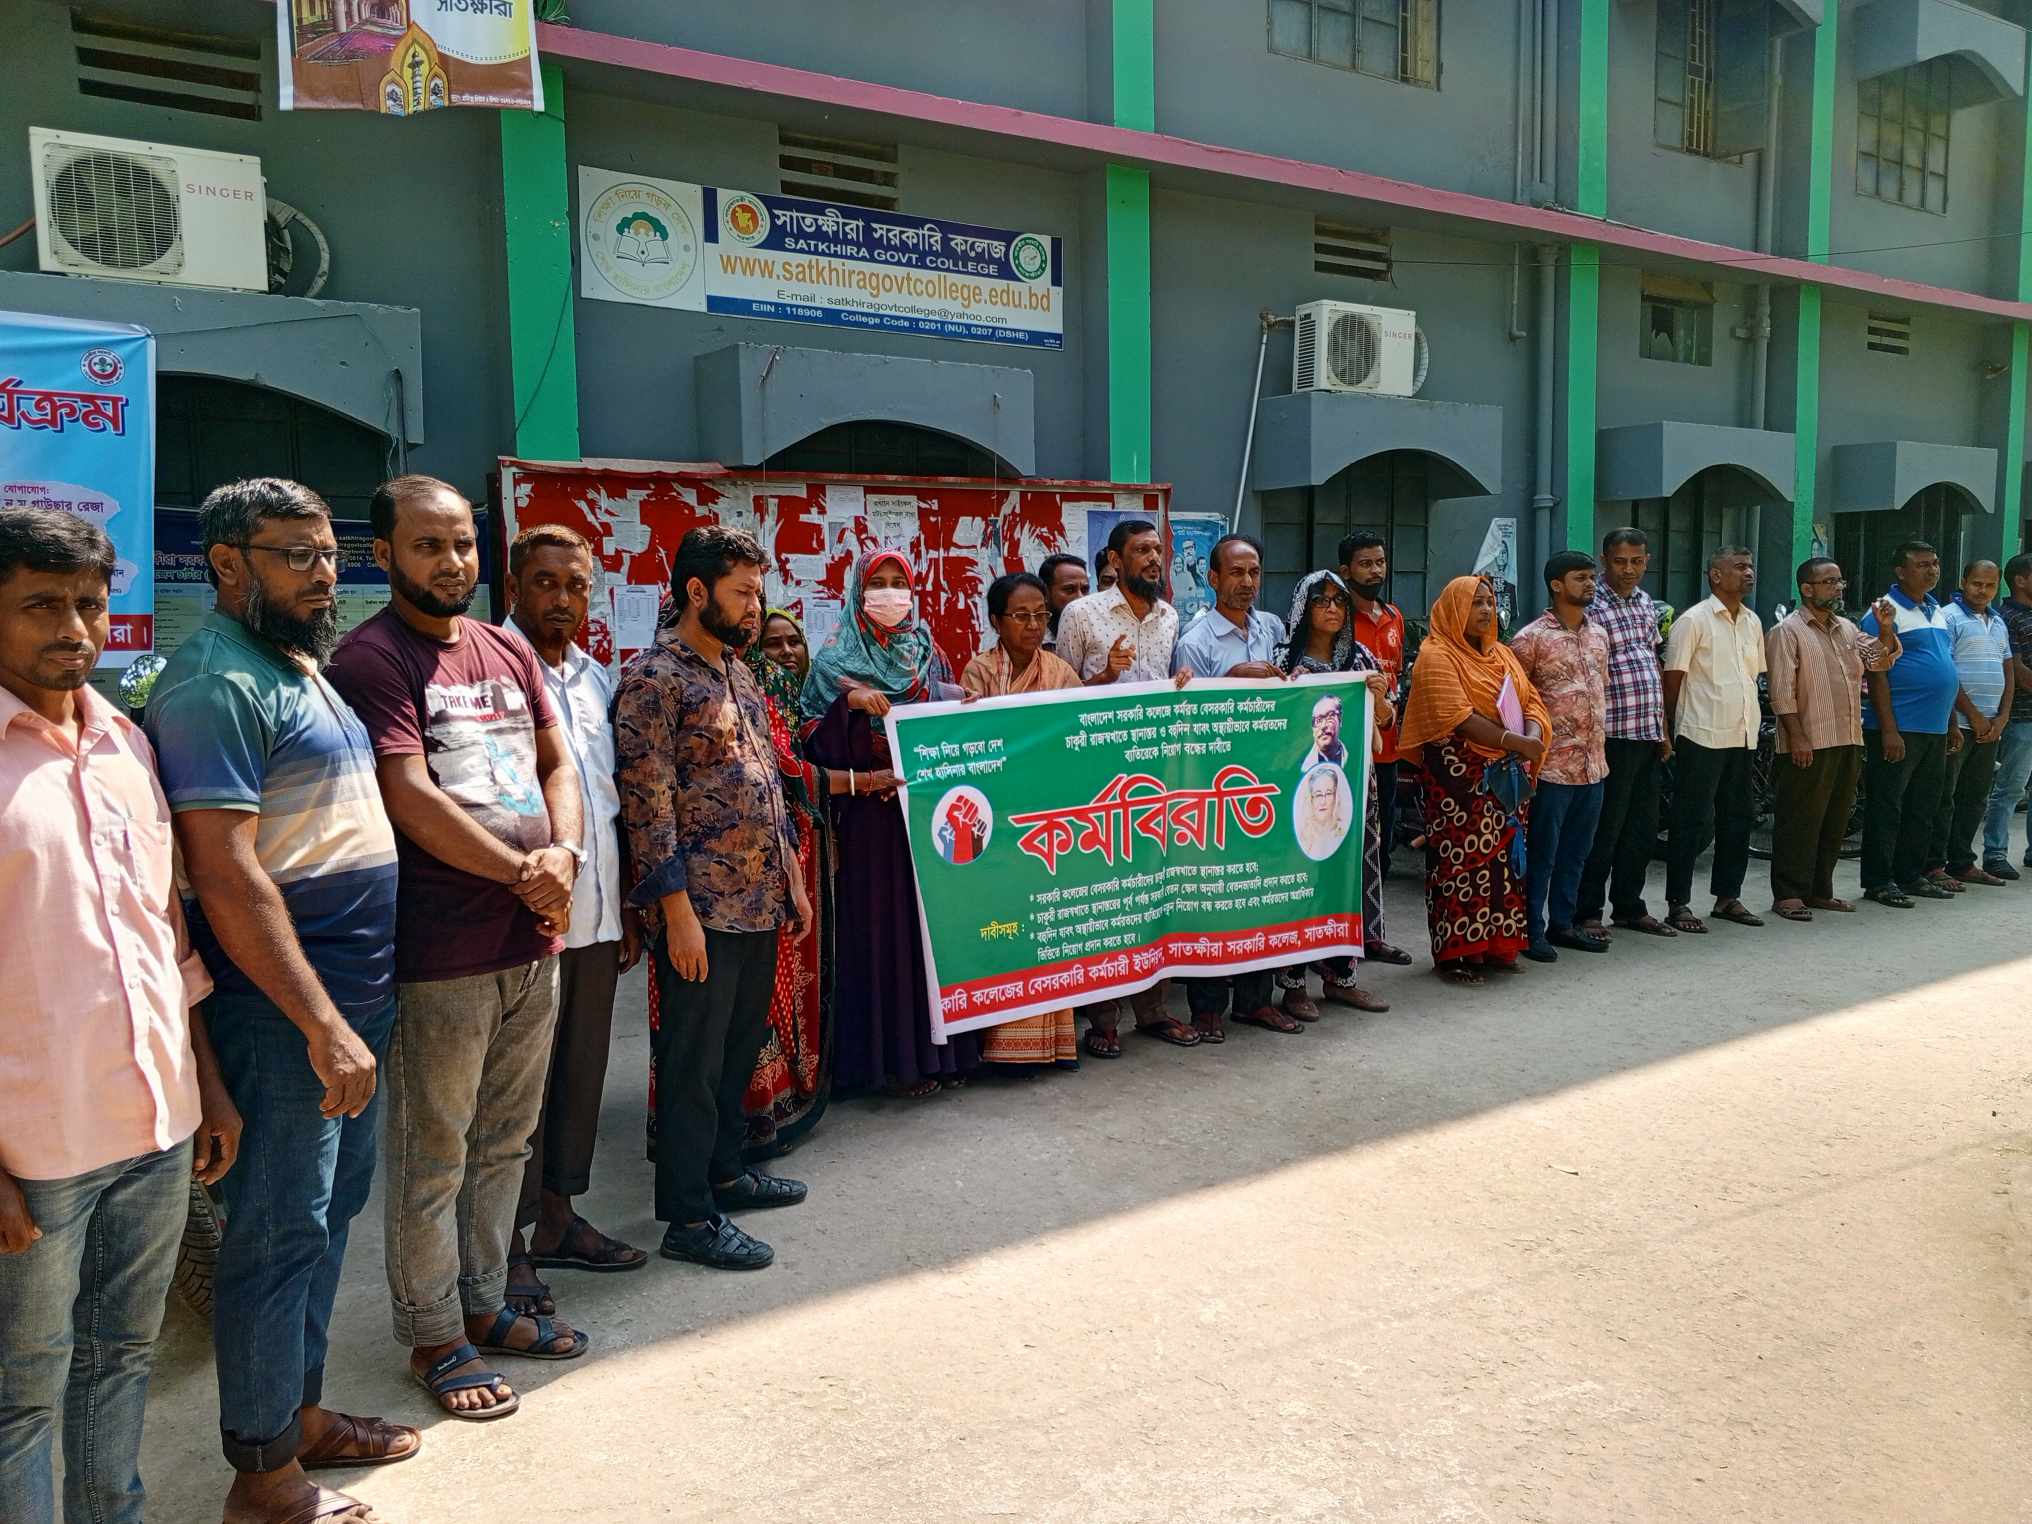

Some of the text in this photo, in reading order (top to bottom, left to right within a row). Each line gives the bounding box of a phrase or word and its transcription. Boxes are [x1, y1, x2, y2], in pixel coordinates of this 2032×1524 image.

[185, 183, 255, 201] SINGER
[772, 208, 865, 244] সাতক্ষীরা
[870, 222, 943, 253] সরকারি
[948, 233, 1007, 262] কলেজ
[784, 237, 870, 259] SATKHIRA
[873, 248, 921, 266] GOVT.
[926, 256, 999, 276] COLLEGE
[720, 254, 1051, 312] www.satkhiragovtcollege.edu.bd
[752, 303, 775, 313] EIIN
[786, 306, 823, 318] 118906
[841, 313, 881, 325] College
[883, 317, 909, 328] Code
[919, 320, 941, 331] 0201
[971, 326, 993, 336] 0207
[995, 329, 1029, 341] (DSHE)
[777, 289, 816, 304] E-mail
[827, 296, 1008, 325] satkhiragovtcollege@yahoo.com
[77, 500, 104, 514] রেজা
[469, 694, 491, 710] ME
[1078, 709, 1114, 728] বাংলাদেশ
[1008, 764, 1281, 876] কর্মবিরতি
[980, 920, 1019, 942] দাবীসমূহ
[941, 988, 969, 1015] কারি
[971, 980, 1024, 1005] কলেজের
[1028, 964, 1086, 994] বেসরকারি
[1088, 954, 1129, 982] কর্মচারী
[1168, 935, 1223, 959] সাতক্ষীরা
[1226, 932, 1265, 953] সরকারি
[1268, 930, 1301, 948] কলেজ,
[1304, 918, 1349, 943] সাতক্ষীরা
